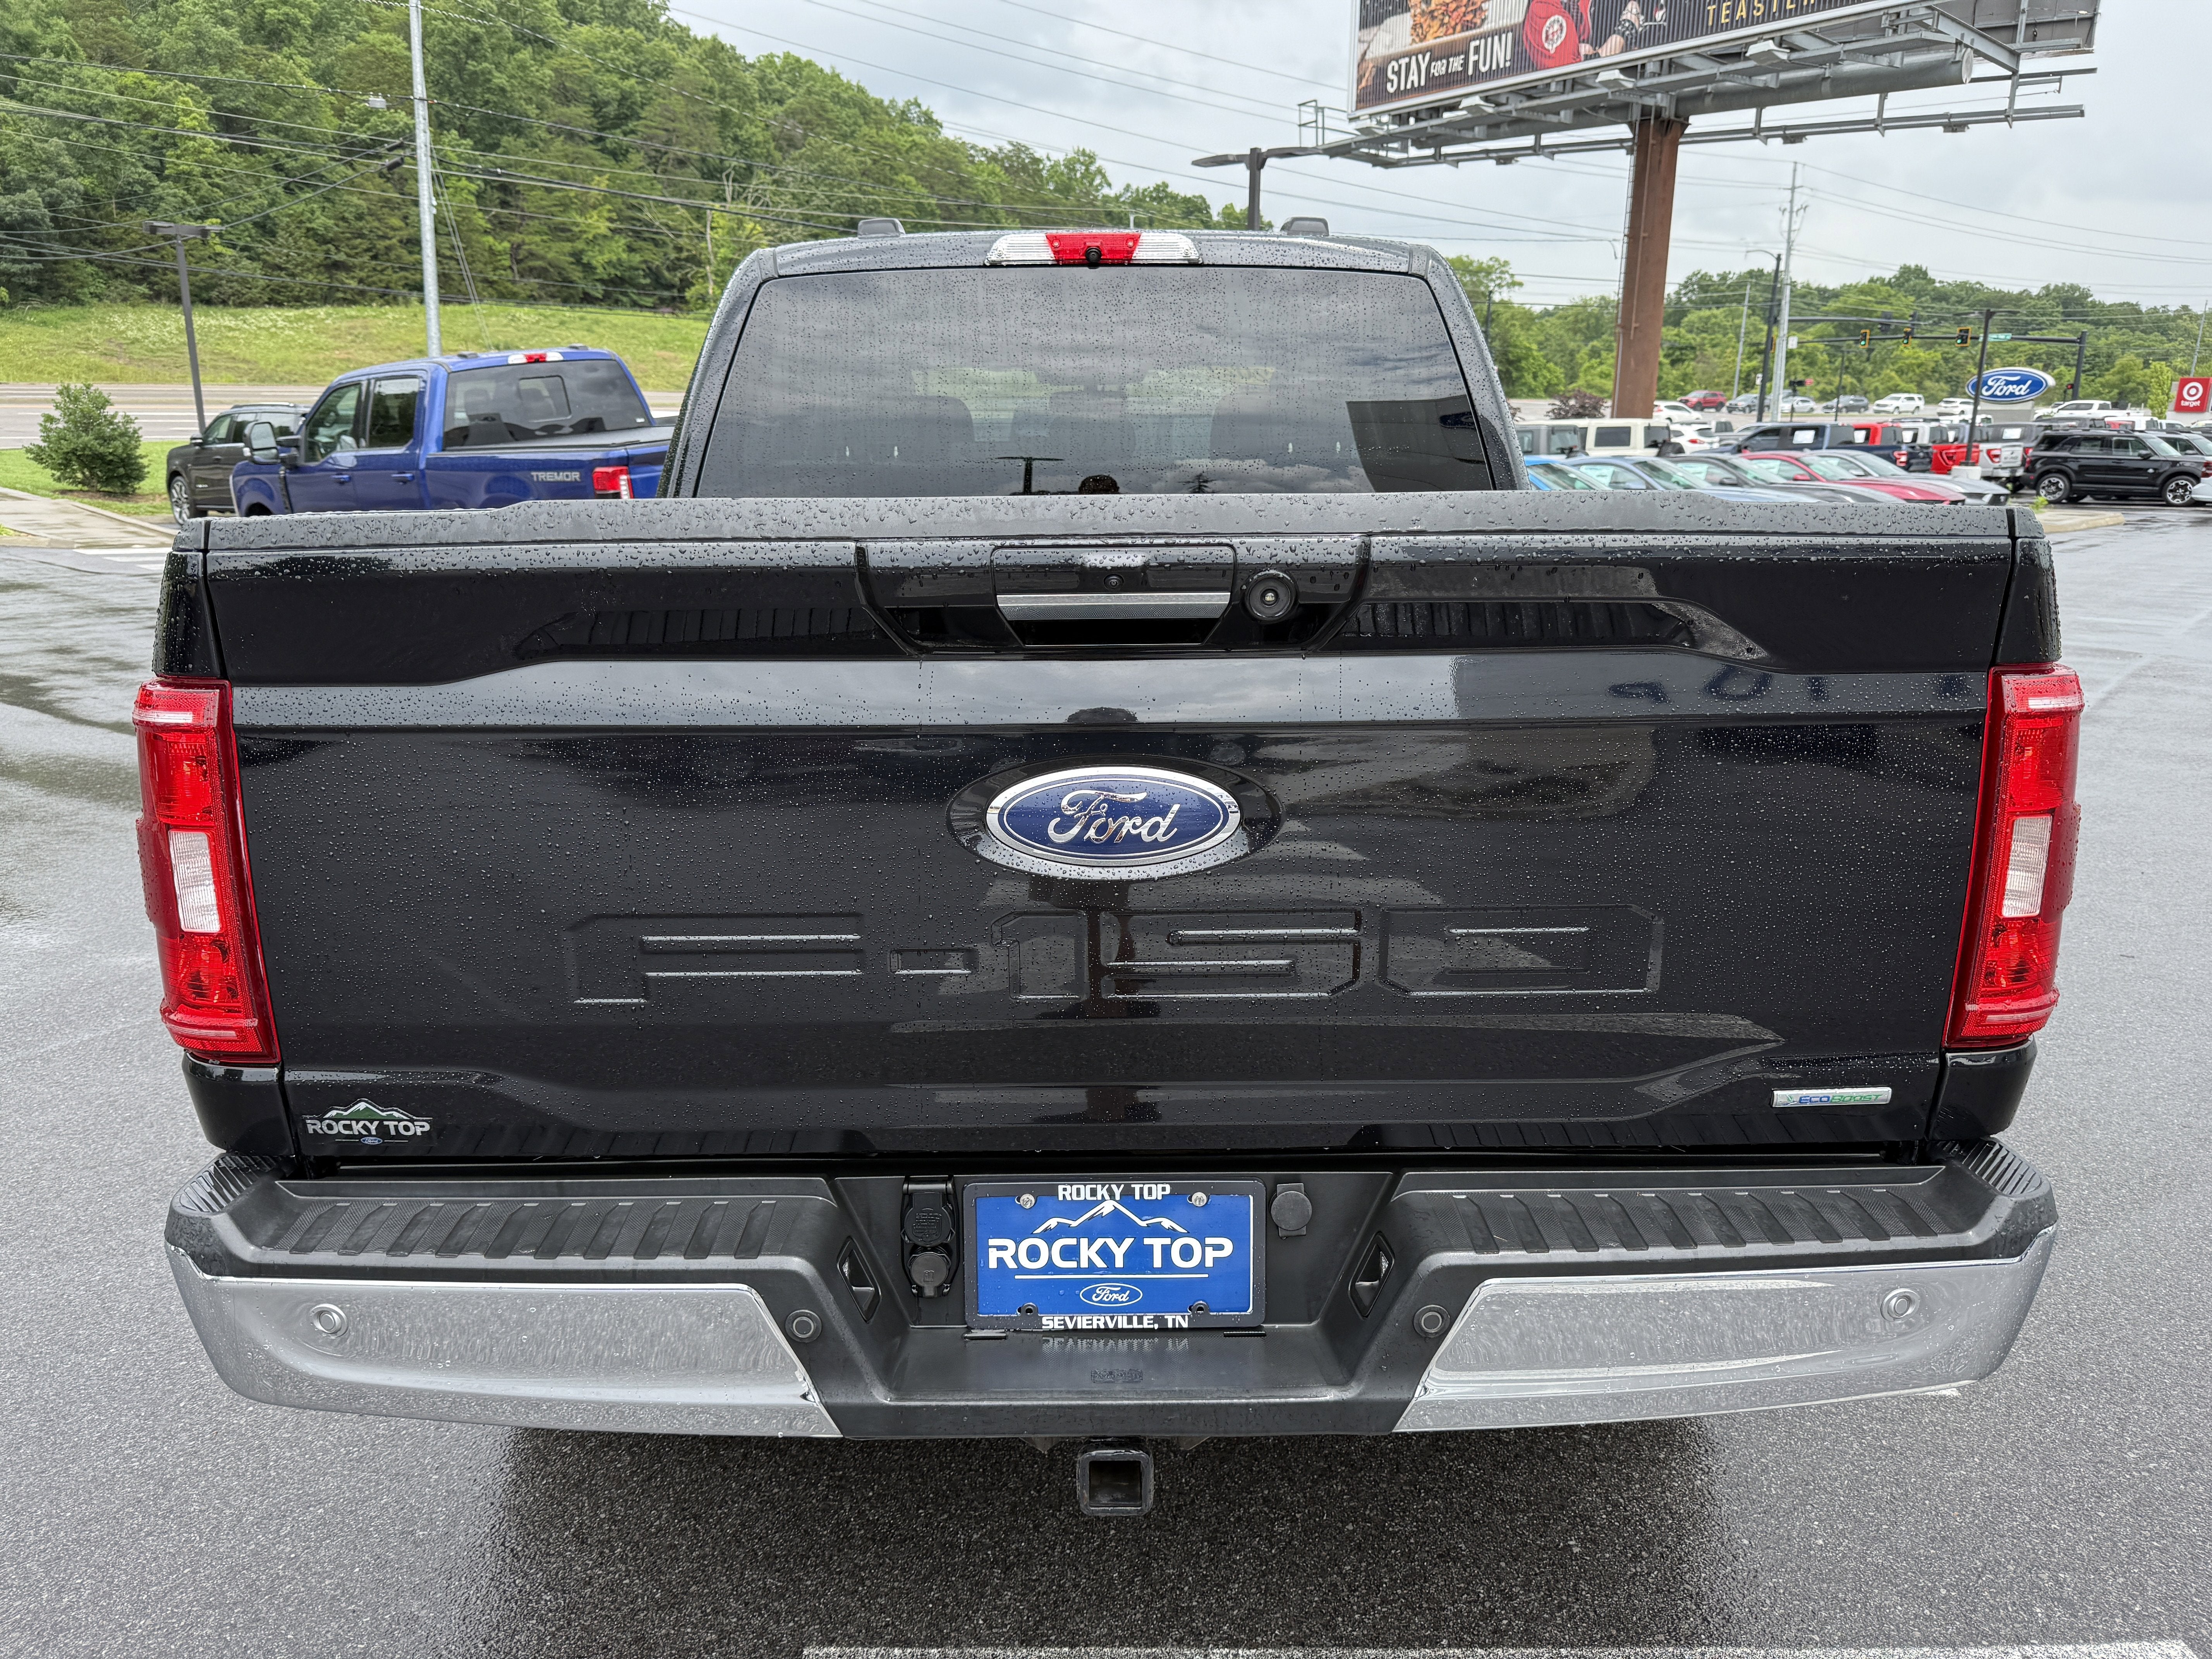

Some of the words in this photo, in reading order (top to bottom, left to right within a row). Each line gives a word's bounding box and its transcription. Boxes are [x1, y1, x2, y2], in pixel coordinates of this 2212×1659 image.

[1707, 0, 1815, 26] TEAS
[1387, 52, 1431, 93] STAY
[1430, 59, 1447, 77] FOR
[1448, 55, 1465, 74] THE
[1468, 32, 1513, 76] FUN!
[1982, 376, 2032, 396] Ford
[531, 471, 581, 482] TREMOR
[1048, 789, 1181, 843] Ford
[565, 904, 1664, 1004] F-150
[306, 1120, 380, 1135] ROCKY
[383, 1121, 431, 1135] TOP
[1058, 1184, 1124, 1201] ROCKY
[1131, 1183, 1171, 1200] TOP
[988, 1237, 1135, 1269] ROCKY
[1144, 1237, 1234, 1269] TOP
[1091, 1286, 1130, 1302] Ford
[1042, 1315, 1159, 1330] SEVIERVILLE,
[1164, 1315, 1189, 1328] TN
